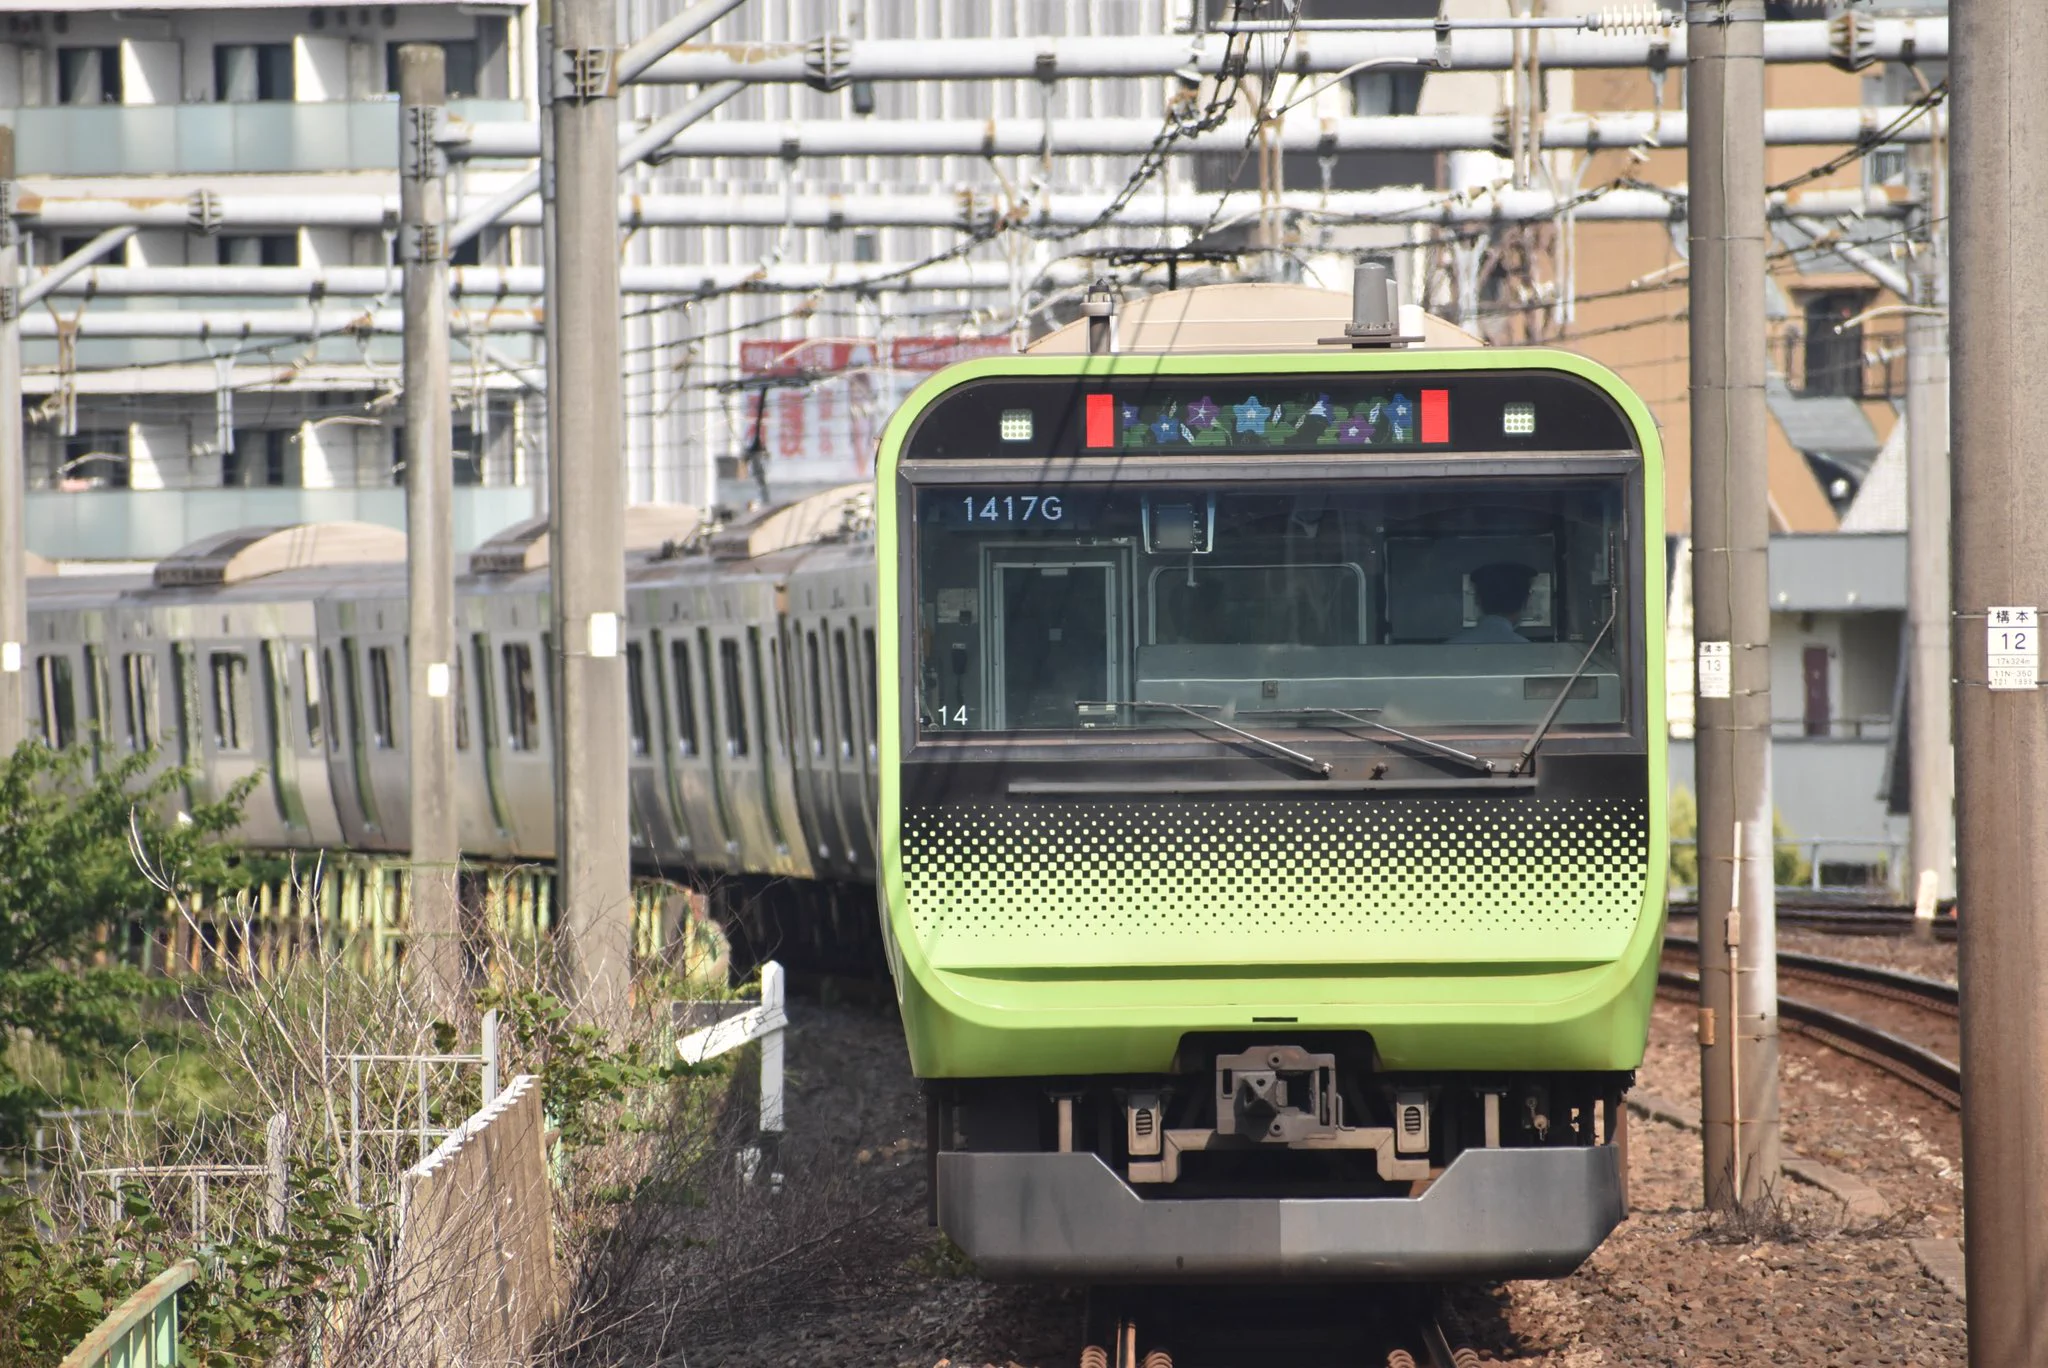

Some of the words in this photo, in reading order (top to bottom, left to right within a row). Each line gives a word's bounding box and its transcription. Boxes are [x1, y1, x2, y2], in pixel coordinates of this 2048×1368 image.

[963, 495, 1063, 521] 1417G
[1996, 610, 2029, 624] 構本
[2001, 632, 2027, 650] 12
[1706, 659, 1721, 672] 13
[938, 705, 968, 726] 14
